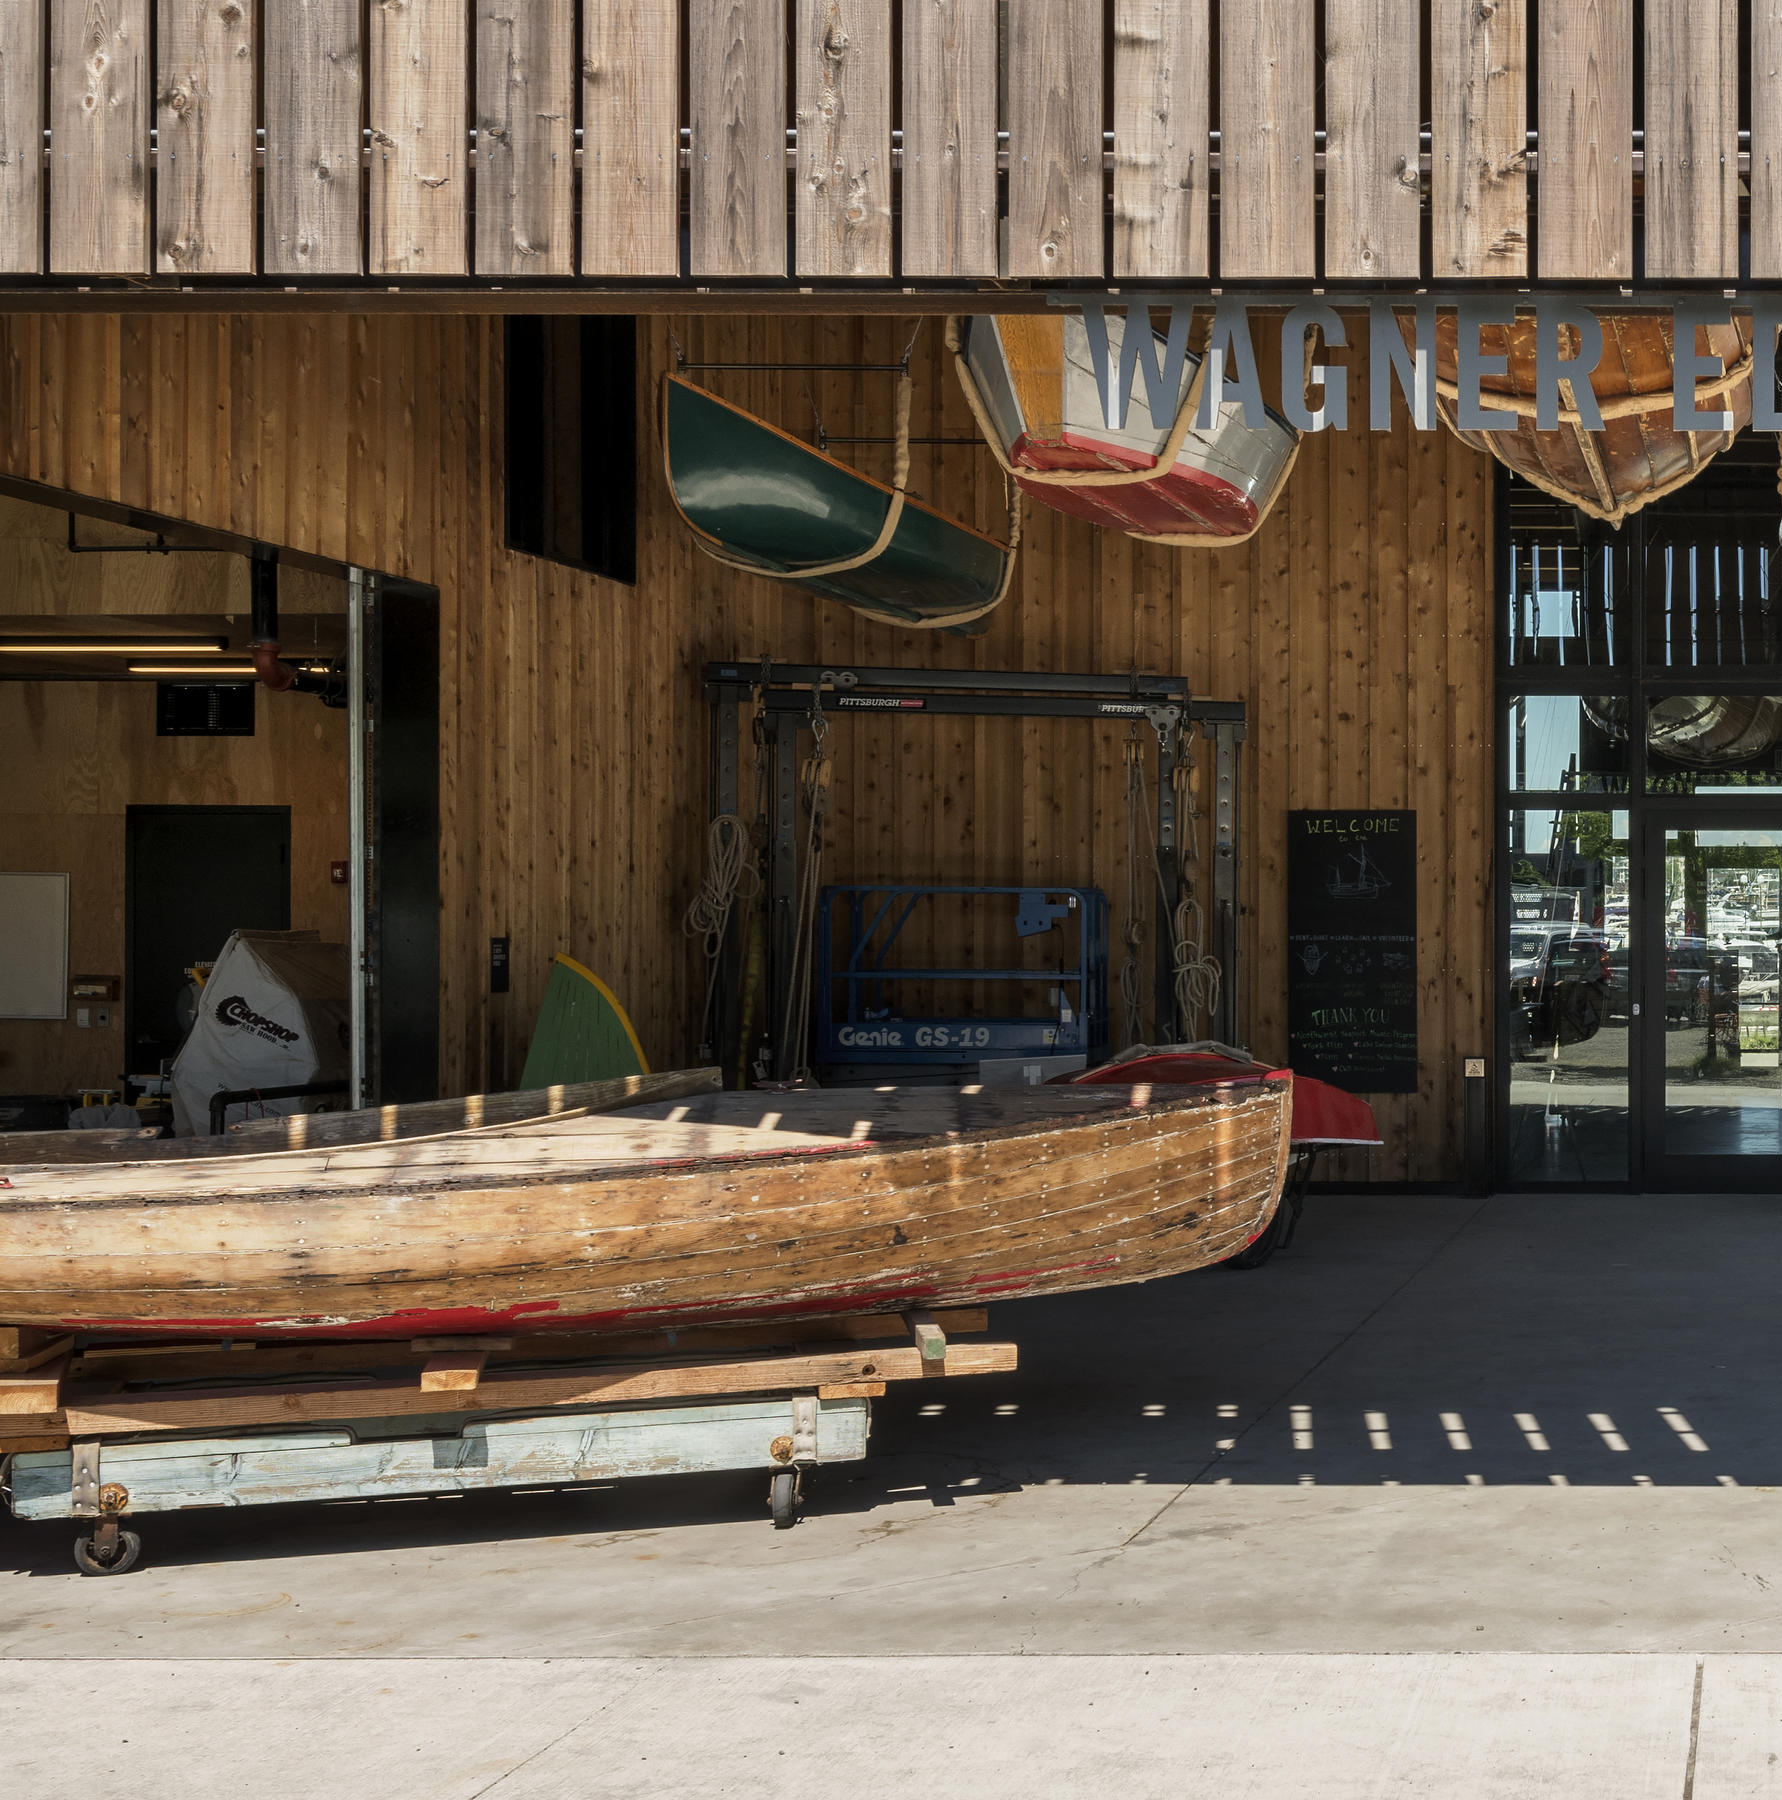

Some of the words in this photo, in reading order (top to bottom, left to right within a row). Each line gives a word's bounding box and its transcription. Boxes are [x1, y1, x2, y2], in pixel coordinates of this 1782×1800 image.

[1081, 300, 1605, 433] WAGNER
[839, 697, 901, 707] PITTSBURGH
[1101, 704, 1146, 713] PITTSBUR
[1306, 818, 1400, 834] WELCOME
[228, 1001, 299, 1043] CHOPSHOP
[1311, 1008, 1357, 1026] THANK
[1359, 1008, 1388, 1024] YOU
[838, 1026, 903, 1047] Genie
[916, 1026, 991, 1047] GS-19
